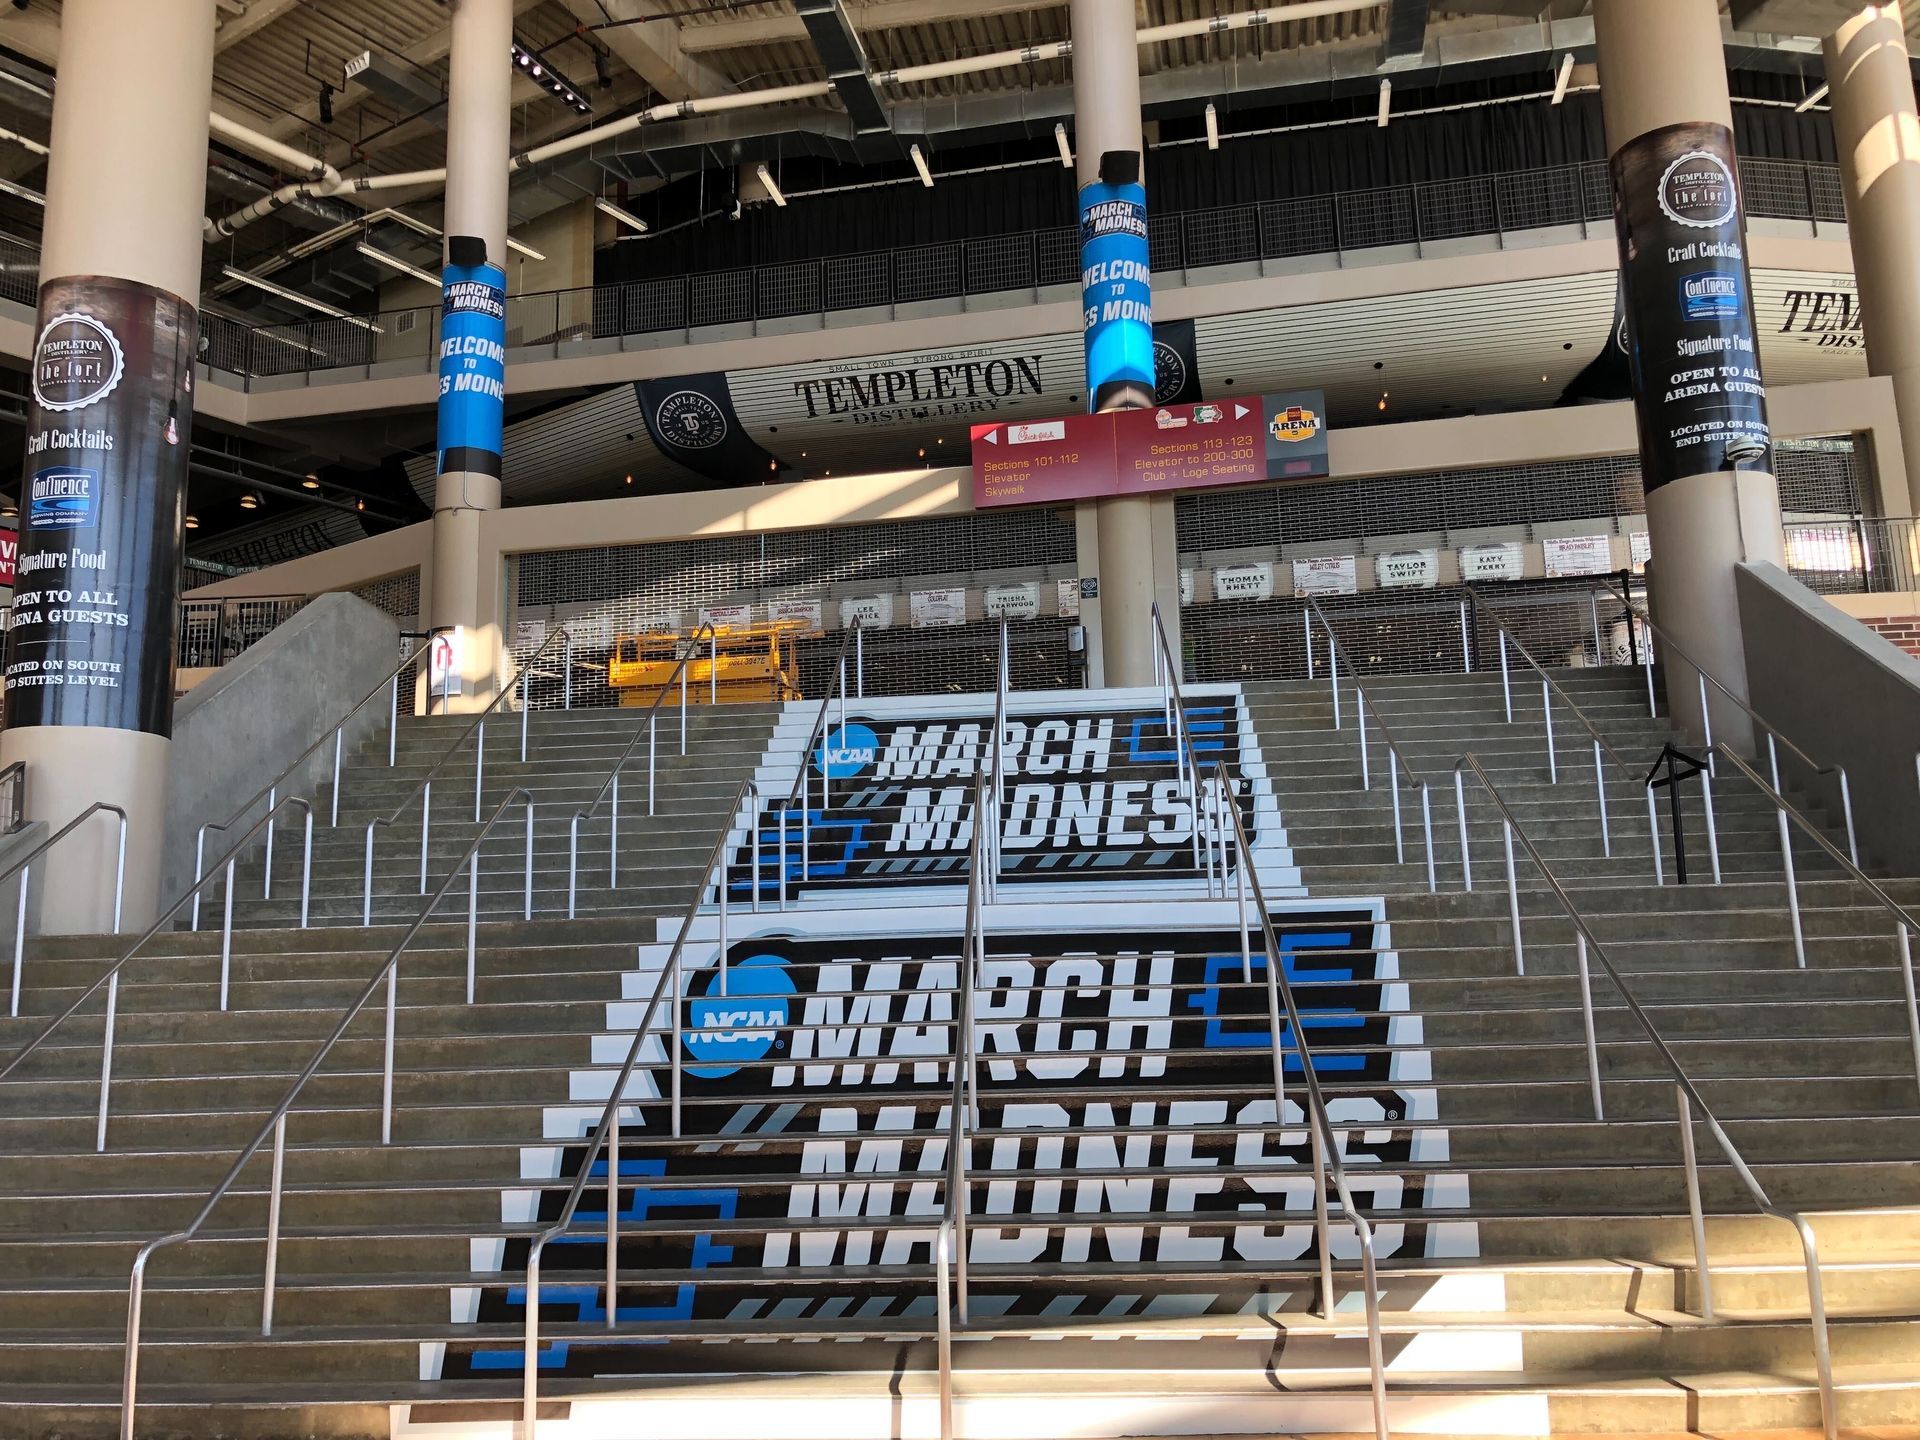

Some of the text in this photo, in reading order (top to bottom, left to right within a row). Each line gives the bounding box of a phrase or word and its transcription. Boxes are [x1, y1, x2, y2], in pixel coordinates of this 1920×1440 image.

[1673, 172, 1725, 184] TEMPLETON
[1675, 190, 1697, 204] the
[1090, 202, 1133, 222] MARCH
[1095, 215, 1146, 236] MADNESS
[1668, 241, 1742, 263] Craft Cocktails
[449, 283, 491, 298] MARCH
[1111, 283, 1126, 296] TO
[1685, 277, 1737, 299] Confluence
[453, 295, 504, 317] MADNESS
[1084, 305, 1099, 332] ES
[43, 340, 103, 355] TEMPLETON
[1677, 334, 1753, 357] Signature Food
[41, 361, 103, 380] the fort
[463, 358, 477, 370] TO
[866, 359, 895, 369] TOWN
[913, 353, 955, 364] STRONG
[1671, 366, 1761, 385] OPEN TO ALL
[439, 372, 504, 404] ES MOINE
[793, 354, 1043, 419] TEMPLETON
[1664, 383, 1721, 403] ARENA
[662, 396, 718, 424] TEMPLETON
[852, 398, 1001, 426] DISTILLERY
[1272, 419, 1317, 432] ARENA
[1670, 421, 1725, 438] LOCATED
[1727, 420, 1743, 429] ON
[28, 429, 114, 456] Craft Cocktails
[666, 425, 722, 446] DISTILLERY
[1676, 437, 1701, 449] END
[1151, 442, 1199, 455] Sections
[984, 453, 1079, 472] Sections 101-112
[1135, 448, 1254, 470] Elevator to 200-300
[984, 472, 1031, 485] Elevator
[1143, 472, 1166, 482] Club
[1182, 468, 1209, 479] Loge
[1212, 463, 1256, 475] Seating
[32, 474, 91, 501] Confluence
[985, 485, 1025, 498] Skywalk
[18, 548, 107, 576] Signature Food
[189, 558, 224, 571] TEMPLETON
[1386, 562, 1427, 571] TAYLOR
[1477, 563, 1506, 571] PERRY
[1479, 555, 1503, 563] KATY
[1221, 574, 1265, 584] THOMAS
[1390, 569, 1425, 578] SWIFT
[1226, 581, 1261, 591] RHETT
[46, 590, 72, 603] TO
[77, 591, 118, 606] ALL
[990, 601, 1034, 609] YEARWOOD
[996, 595, 1026, 603] TRISHA
[10, 610, 129, 630] RENA GUESTS
[6, 660, 122, 677] OCATED ON SOUTH
[17, 675, 64, 688] SUITES
[67, 674, 119, 687] LEVEL
[822, 748, 873, 765] NCAA
[871, 718, 1114, 781] MARCH
[884, 778, 1243, 852] MADNESS
[689, 1010, 785, 1044] NCAA
[770, 949, 1175, 1087] MARCH
[761, 1096, 1408, 1268] MADNESS
